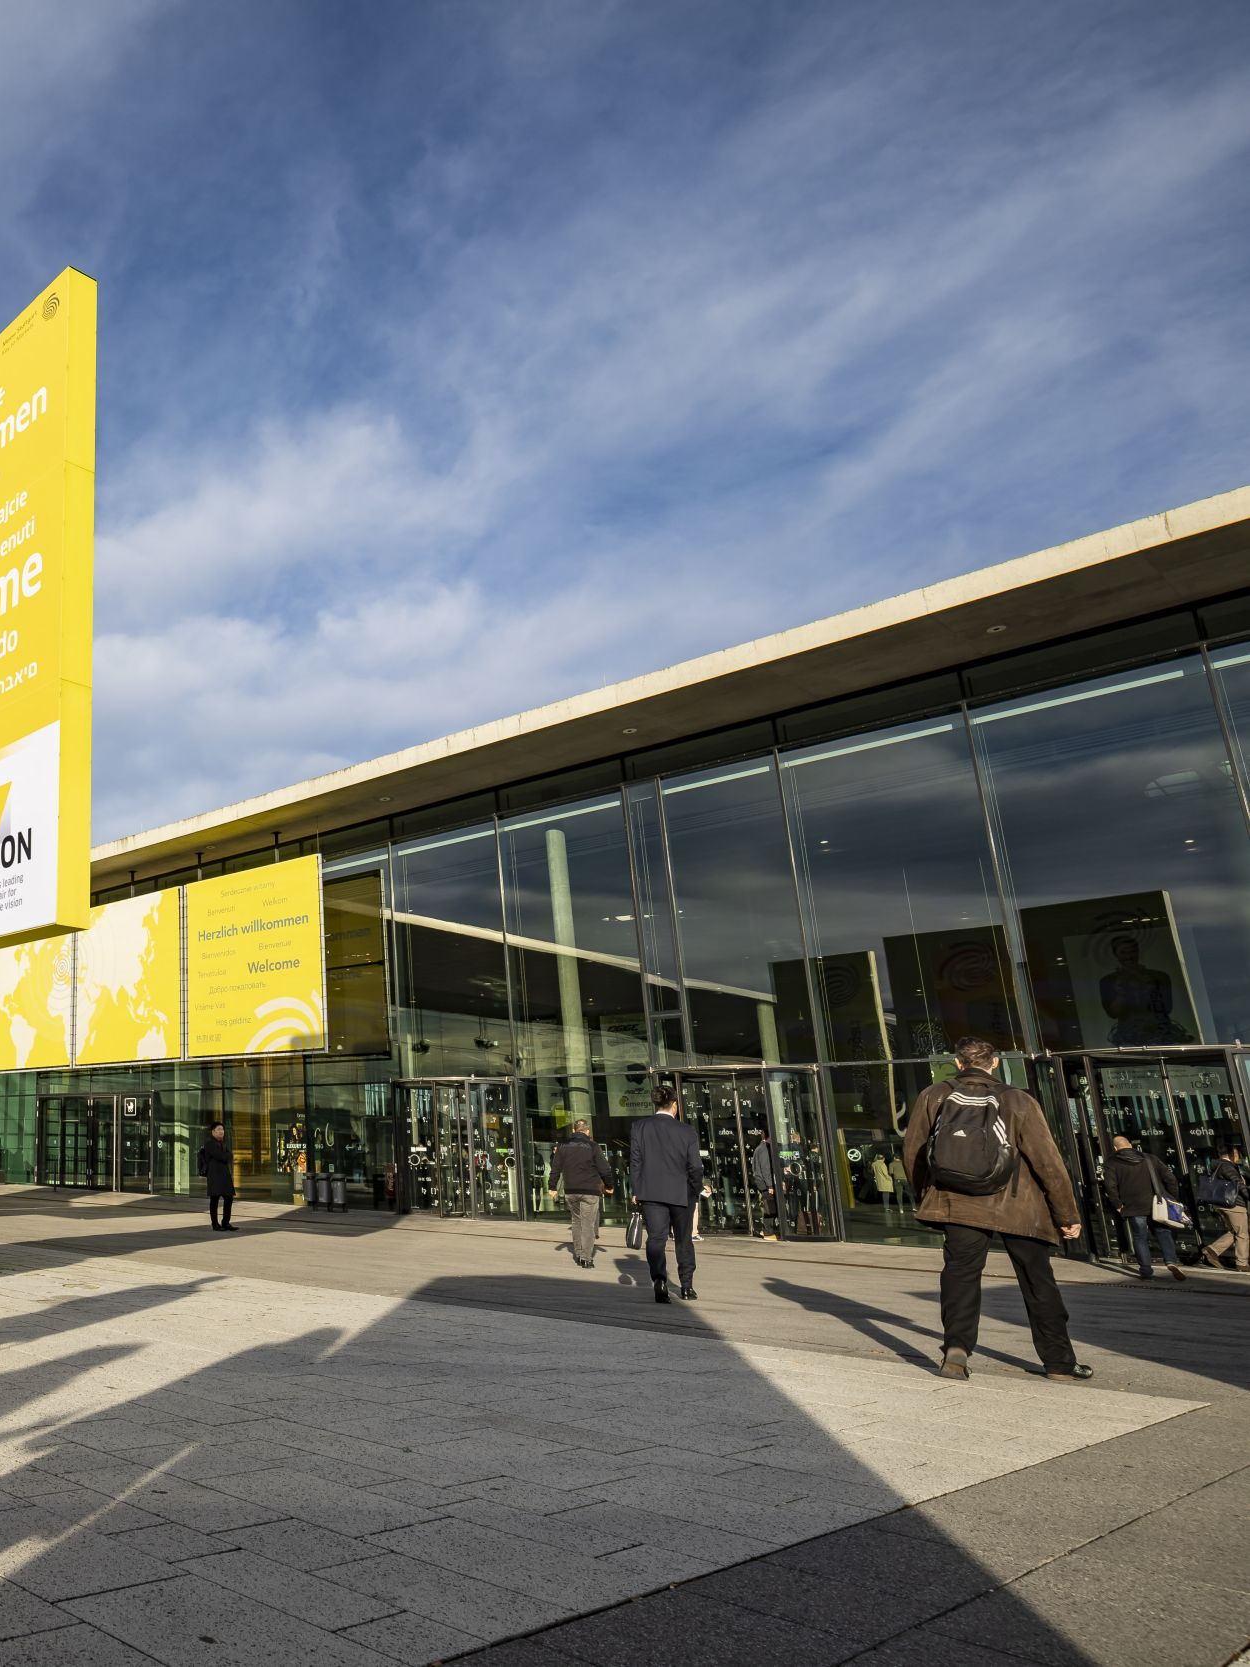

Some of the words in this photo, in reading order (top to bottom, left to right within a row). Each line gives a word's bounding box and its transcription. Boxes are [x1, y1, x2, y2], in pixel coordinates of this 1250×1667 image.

[2, 874, 24, 890] leading
[7, 887, 17, 899] for
[4, 897, 23, 911] vision
[198, 924, 239, 942] Herzlich
[241, 914, 310, 935] willkommen
[247, 958, 301, 974] Welcome
